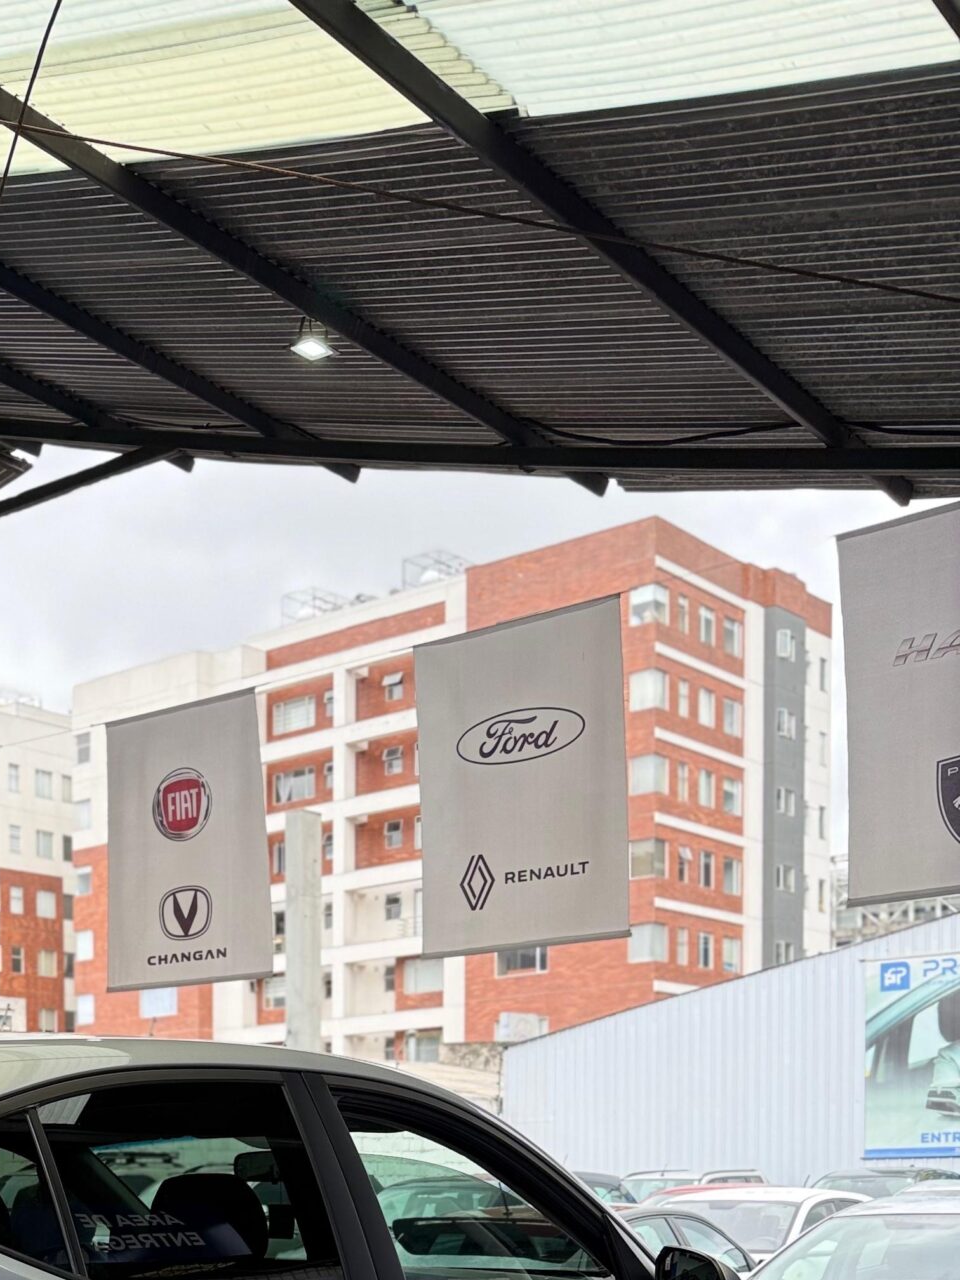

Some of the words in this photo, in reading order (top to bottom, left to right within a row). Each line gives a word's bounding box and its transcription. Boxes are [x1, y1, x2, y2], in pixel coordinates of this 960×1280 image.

[479, 715, 559, 758] Ford
[167, 787, 199, 822] FIAT
[504, 861, 589, 884] RENAULT
[147, 947, 227, 966] CHANGAN
